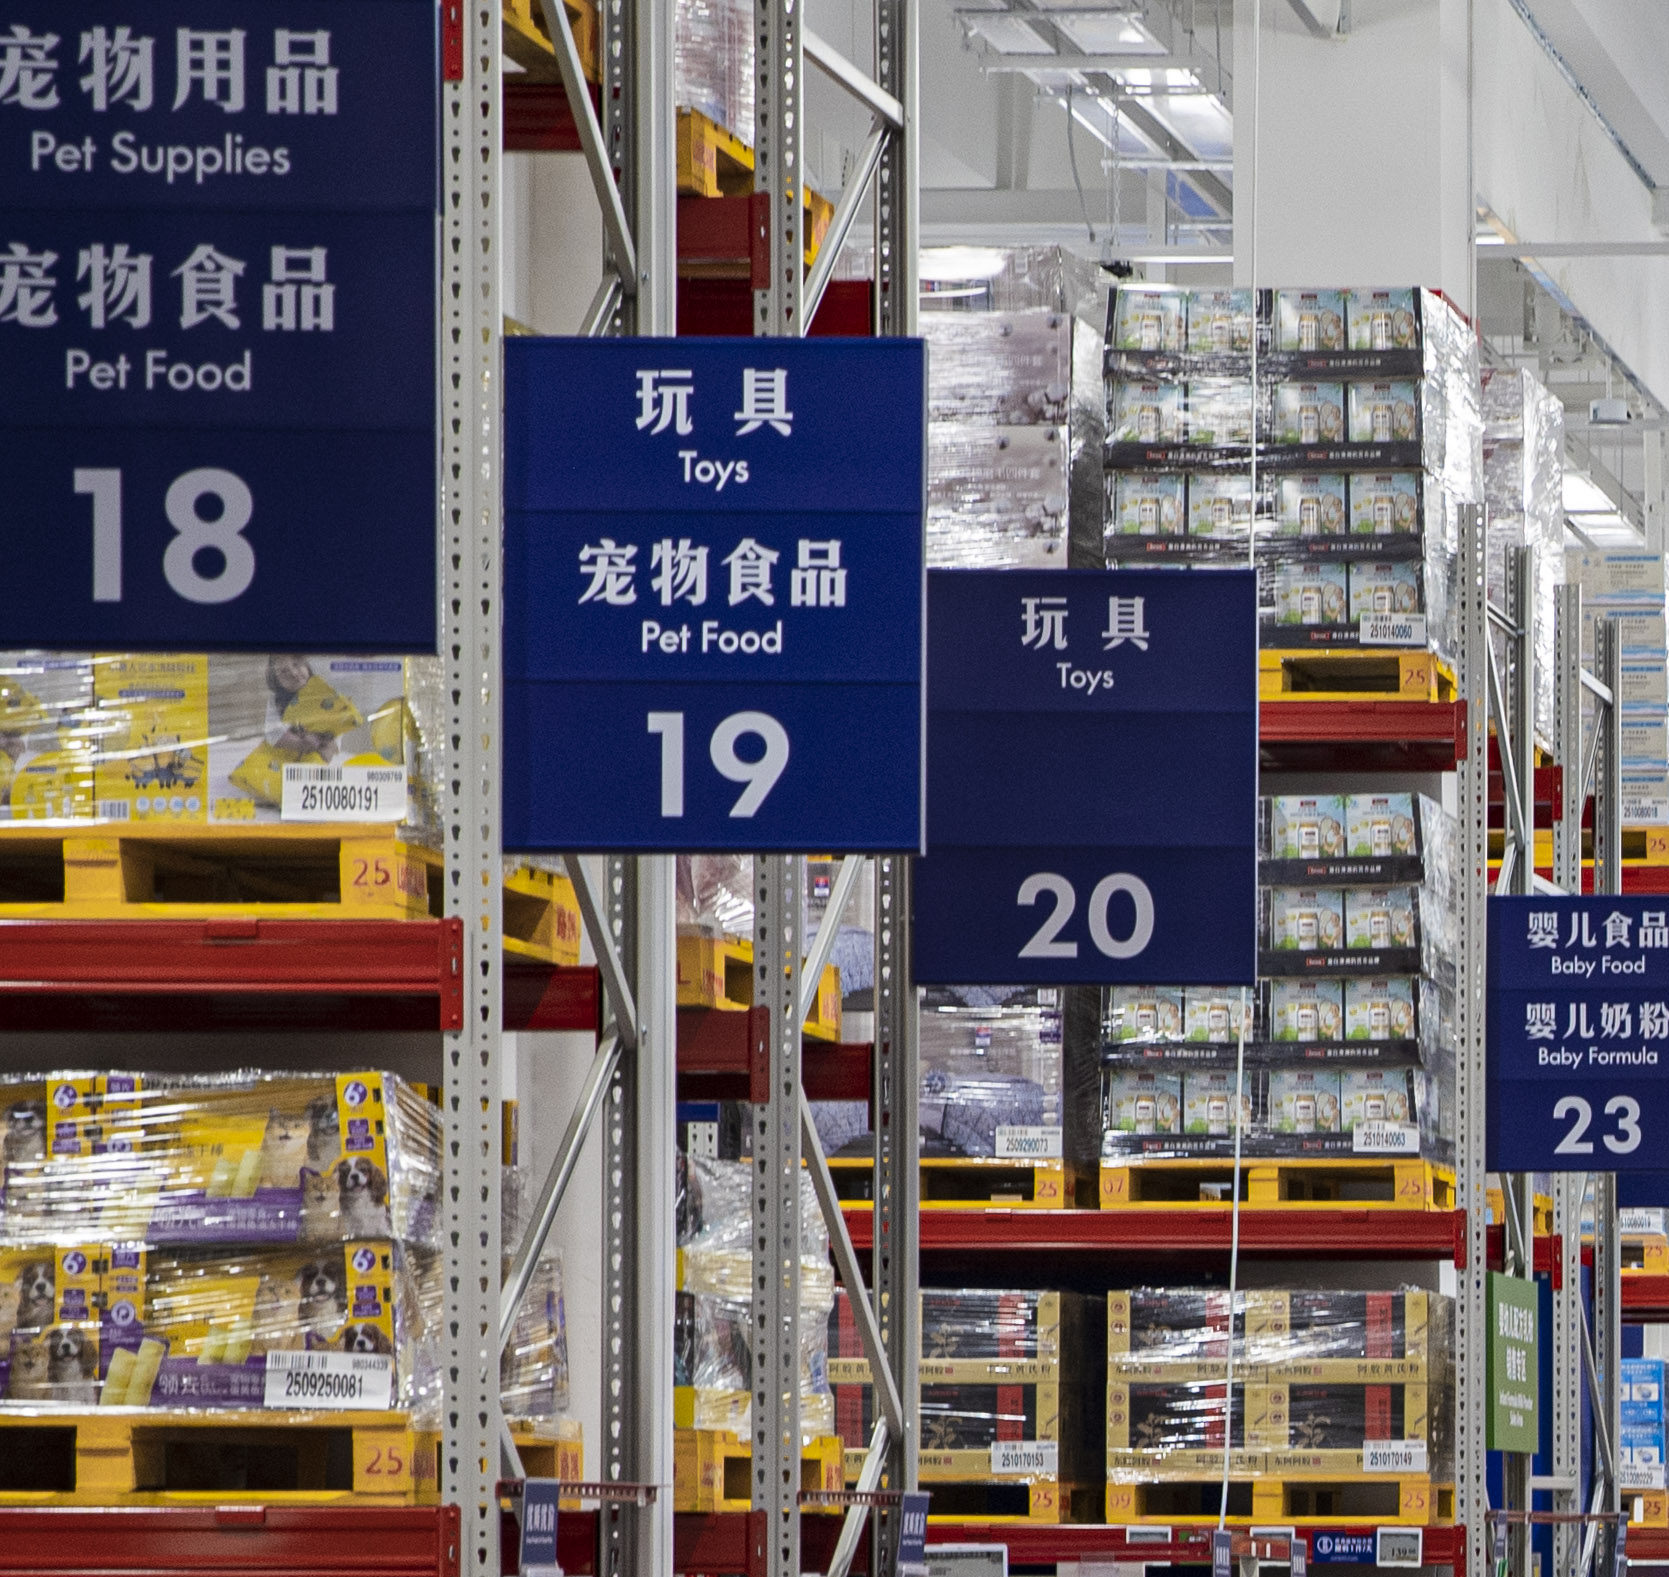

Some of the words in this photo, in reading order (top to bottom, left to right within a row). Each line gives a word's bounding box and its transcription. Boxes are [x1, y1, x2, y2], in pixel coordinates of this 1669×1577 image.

[0, 26, 339, 115] 宠物用品
[31, 132, 97, 172] Pet
[110, 132, 290, 184] Supplies
[0, 244, 336, 331] 宠物食品
[66, 352, 131, 390] Pet
[145, 350, 252, 392] Food
[636, 367, 793, 437] 玩具
[678, 451, 749, 490] Toys
[73, 467, 255, 605] 18
[578, 540, 847, 608] 宠物食品
[641, 622, 692, 654] Pet
[701, 621, 783, 655] Food
[1021, 597, 1150, 651] 玩具
[1370, 625, 1413, 639] 2510140060
[1056, 662, 1114, 696] Toys
[1405, 669, 1426, 686] 25
[646, 710, 790, 819] 19
[302, 785, 379, 812] 2510080191
[1649, 838, 1667, 851] 25
[352, 858, 391, 888] 25
[1016, 872, 1155, 959] 20
[1527, 911, 1669, 950] 婴儿食品
[1551, 956, 1596, 978] Baby
[1601, 956, 1646, 974] Food
[1538, 1047, 1584, 1070] Baby
[1588, 1047, 1658, 1066] Formula
[1363, 1132, 1406, 1146] 2510140063
[1553, 1095, 1642, 1155] 23
[1037, 1181, 1058, 1198] 25
[1102, 1177, 1124, 1195] 07
[1400, 1176, 1421, 1194] 25
[285, 1372, 363, 1399] 2509250081
[365, 1446, 403, 1475] 25
[1002, 1453, 1044, 1467] 2510170153
[1370, 1452, 1412, 1466] 2510170149
[1032, 1491, 1053, 1509] 25
[1404, 1491, 1426, 1509] 25
